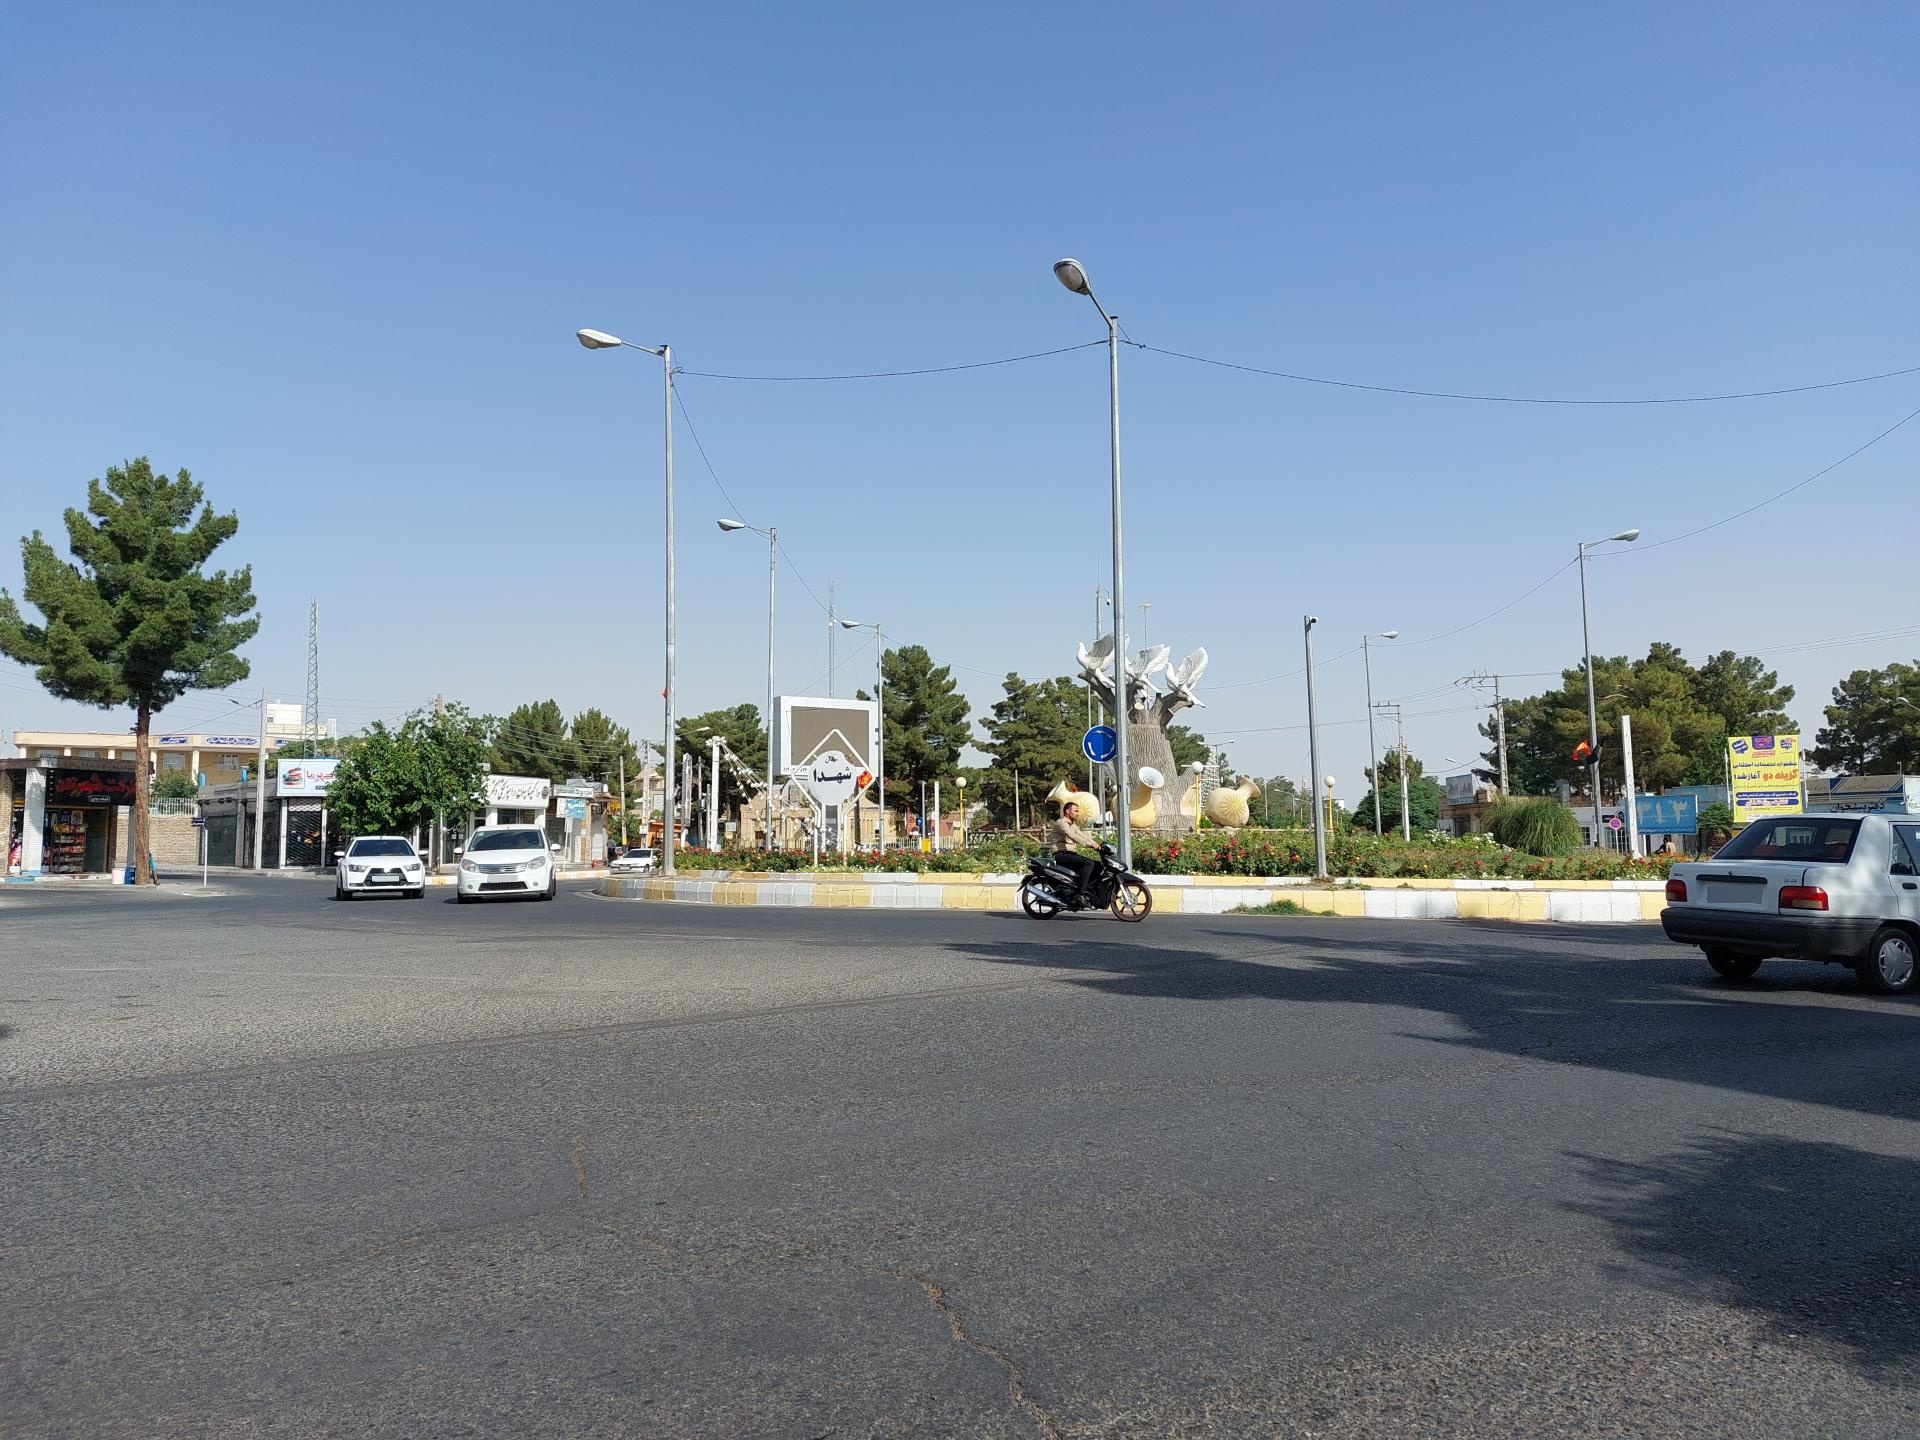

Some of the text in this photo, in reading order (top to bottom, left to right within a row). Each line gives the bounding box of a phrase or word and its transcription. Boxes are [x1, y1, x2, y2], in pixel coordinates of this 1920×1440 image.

[813, 766, 852, 784] شهدا
[1763, 772, 1774, 781] دو
[1775, 769, 1799, 781] گزینه
[1861, 802, 1885, 813] دفتر
